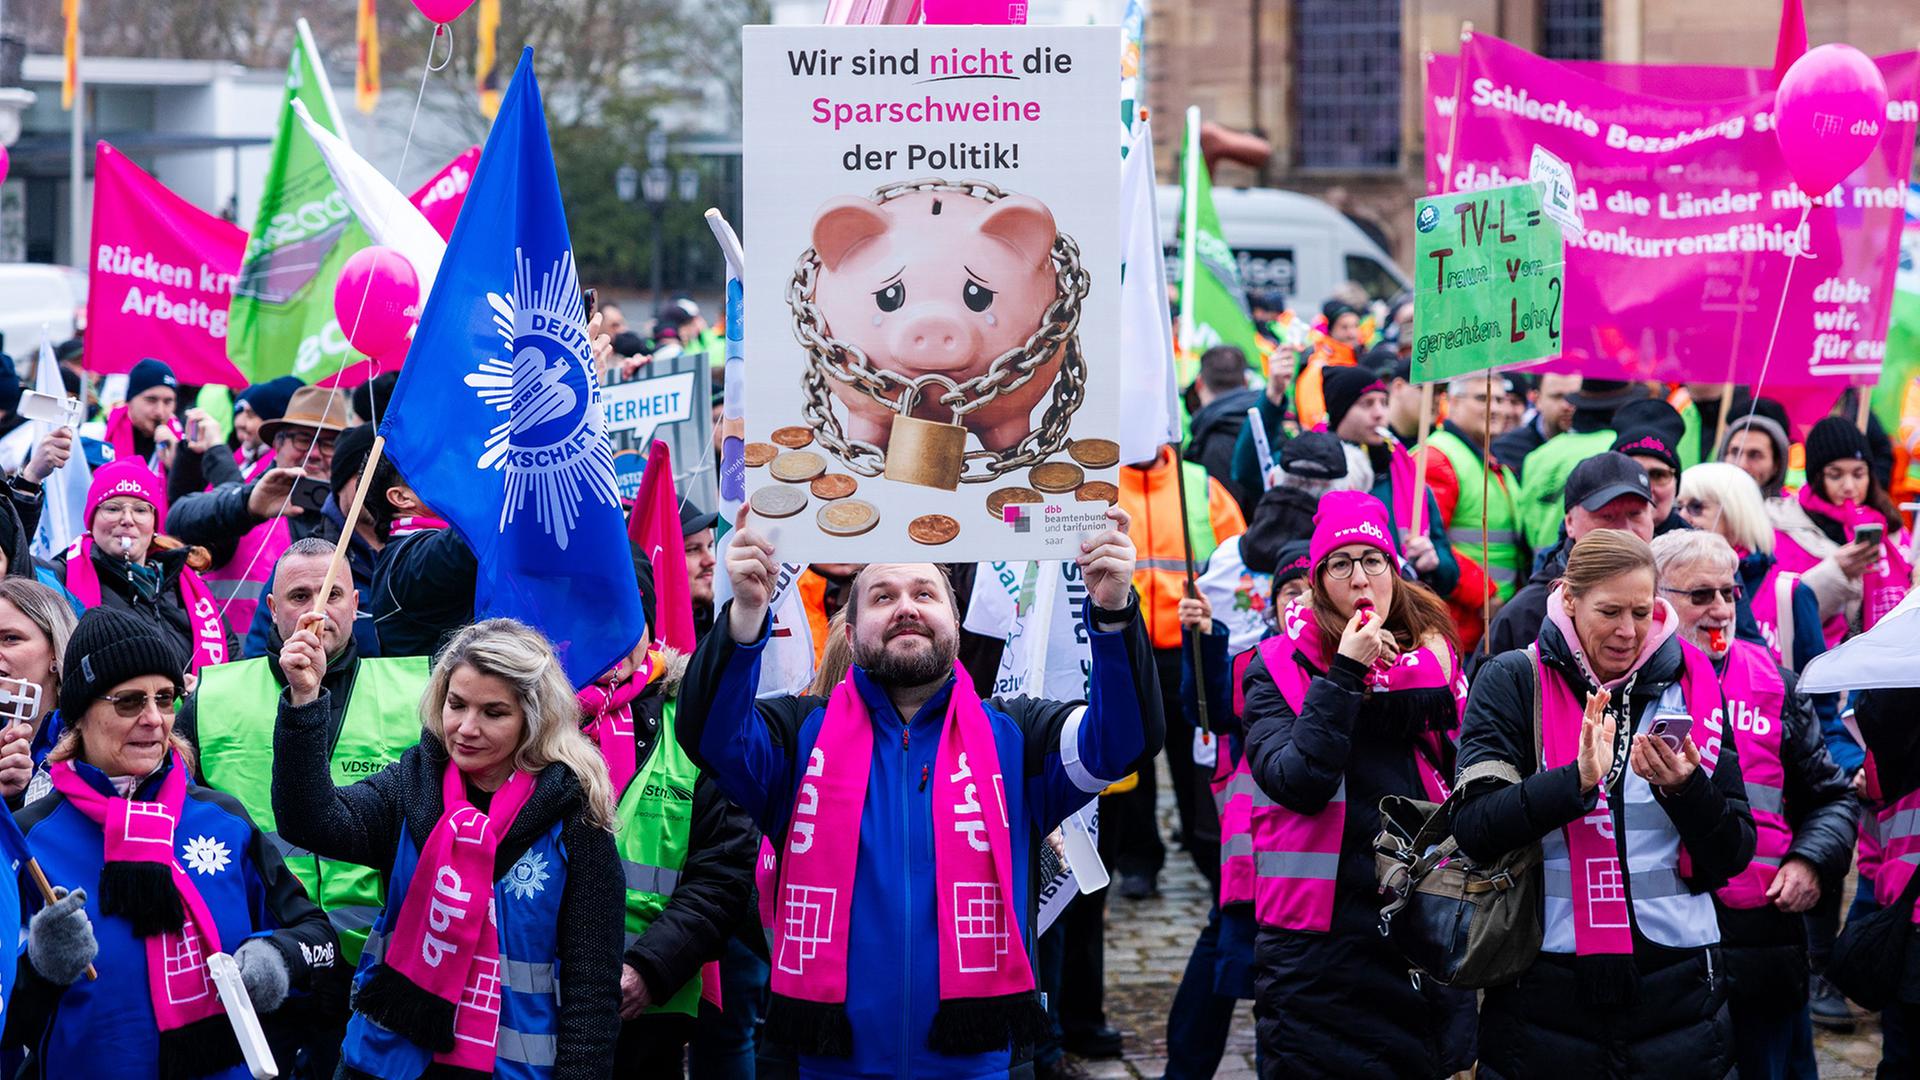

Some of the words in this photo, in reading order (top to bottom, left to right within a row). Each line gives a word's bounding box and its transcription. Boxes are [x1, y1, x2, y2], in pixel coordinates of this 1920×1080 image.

[788, 49, 842, 76] Wir
[851, 48, 919, 76] sind
[930, 47, 1013, 75] nicht
[1022, 46, 1072, 74] die
[812, 95, 1041, 130] Sparschweine
[1471, 78, 1600, 137] Schlechte
[1850, 119, 1879, 136] dbb
[842, 143, 897, 171] der
[907, 142, 1019, 170] Politik!
[1606, 190, 1650, 216] die
[1659, 188, 1763, 219] Länder
[1771, 181, 1844, 209] nit
[1453, 199, 1517, 248] TV-L
[97, 244, 193, 289] Rücken
[1429, 248, 1489, 294] Traum
[1812, 277, 1872, 304] dbb:
[1813, 305, 1861, 332] wir.
[531, 314, 602, 404] DEUTSCHE
[1809, 333, 1853, 366] für
[1044, 505, 1062, 514] dbb
[1044, 513, 1107, 523] beamtenbund
[1044, 524, 1061, 533] und
[1062, 522, 1107, 532] tarifunion
[1044, 537, 1064, 545] saar
[422, 864, 472, 969] dbb
